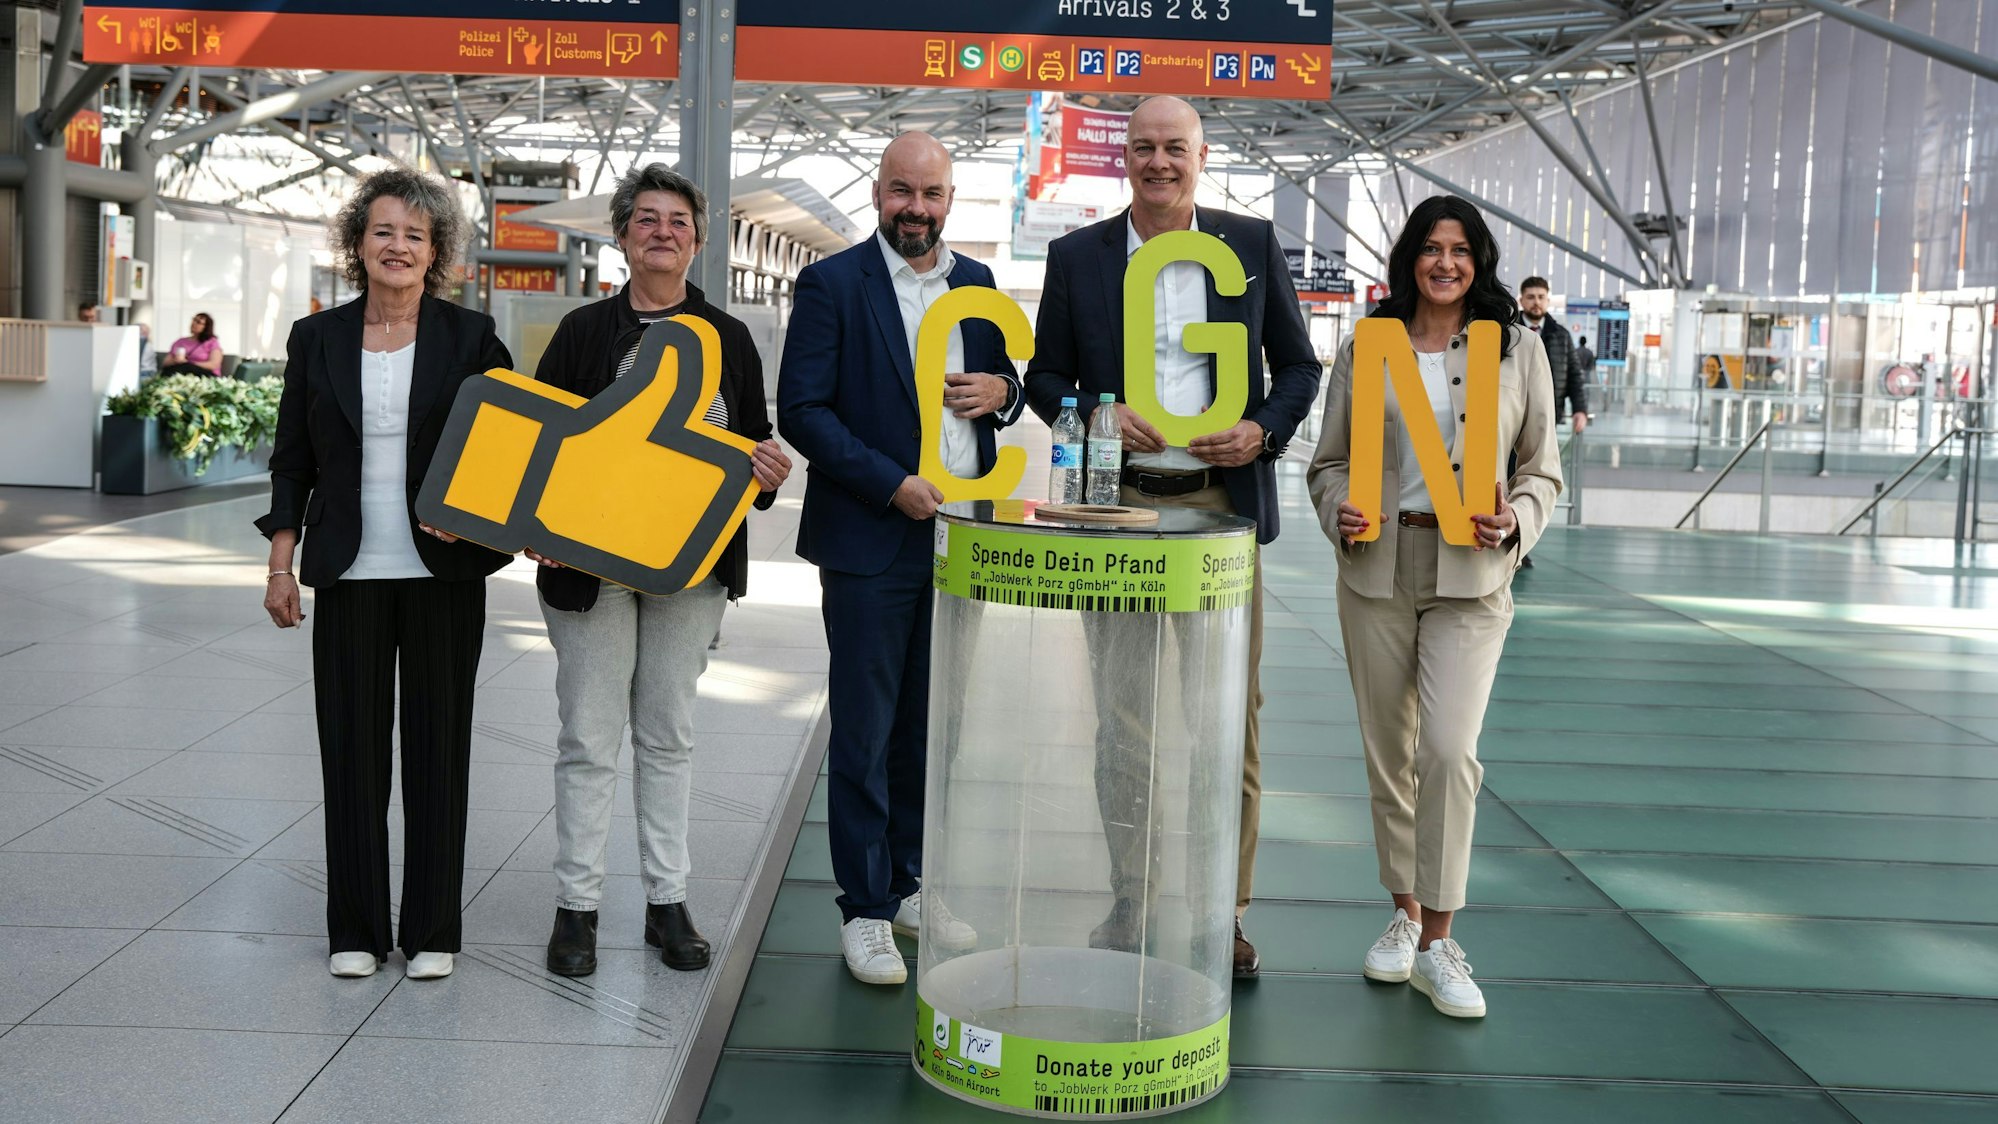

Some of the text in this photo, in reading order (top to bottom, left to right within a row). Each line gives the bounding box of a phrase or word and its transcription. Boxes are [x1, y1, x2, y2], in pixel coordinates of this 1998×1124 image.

[1058, 0, 1230, 20] Arrivals 2 & 3
[139, 17, 156, 29] WC
[176, 22, 192, 34] WC
[459, 30, 501, 42] Polizei
[555, 33, 578, 45] Zoll
[459, 45, 494, 57] Police
[554, 47, 603, 60] Customs
[963, 47, 982, 68] S
[1143, 54, 1204, 69] Carsharing
[1251, 56, 1275, 79] PN
[1078, 128, 1106, 144] HALLO
[1124, 230, 1249, 448] G
[916, 286, 1036, 501] C
[1349, 318, 1502, 546] N
[972, 542, 1166, 574] Spende Dein Pfand
[1202, 552, 1246, 578] Spende
[970, 570, 980, 580] an
[1038, 576, 1063, 589] Porz
[1123, 581, 1135, 592] in
[1141, 580, 1166, 592] Köln
[1200, 582, 1211, 591] an
[1036, 1036, 1221, 1081] Donate your deposit
[946, 1070, 964, 1087] Bonn
[966, 1078, 1001, 1097] Airport
[1034, 1080, 1048, 1092] to
[1114, 1083, 1138, 1093] Porz
[1185, 1072, 1194, 1084] in
[1196, 1060, 1220, 1078] Cologne
